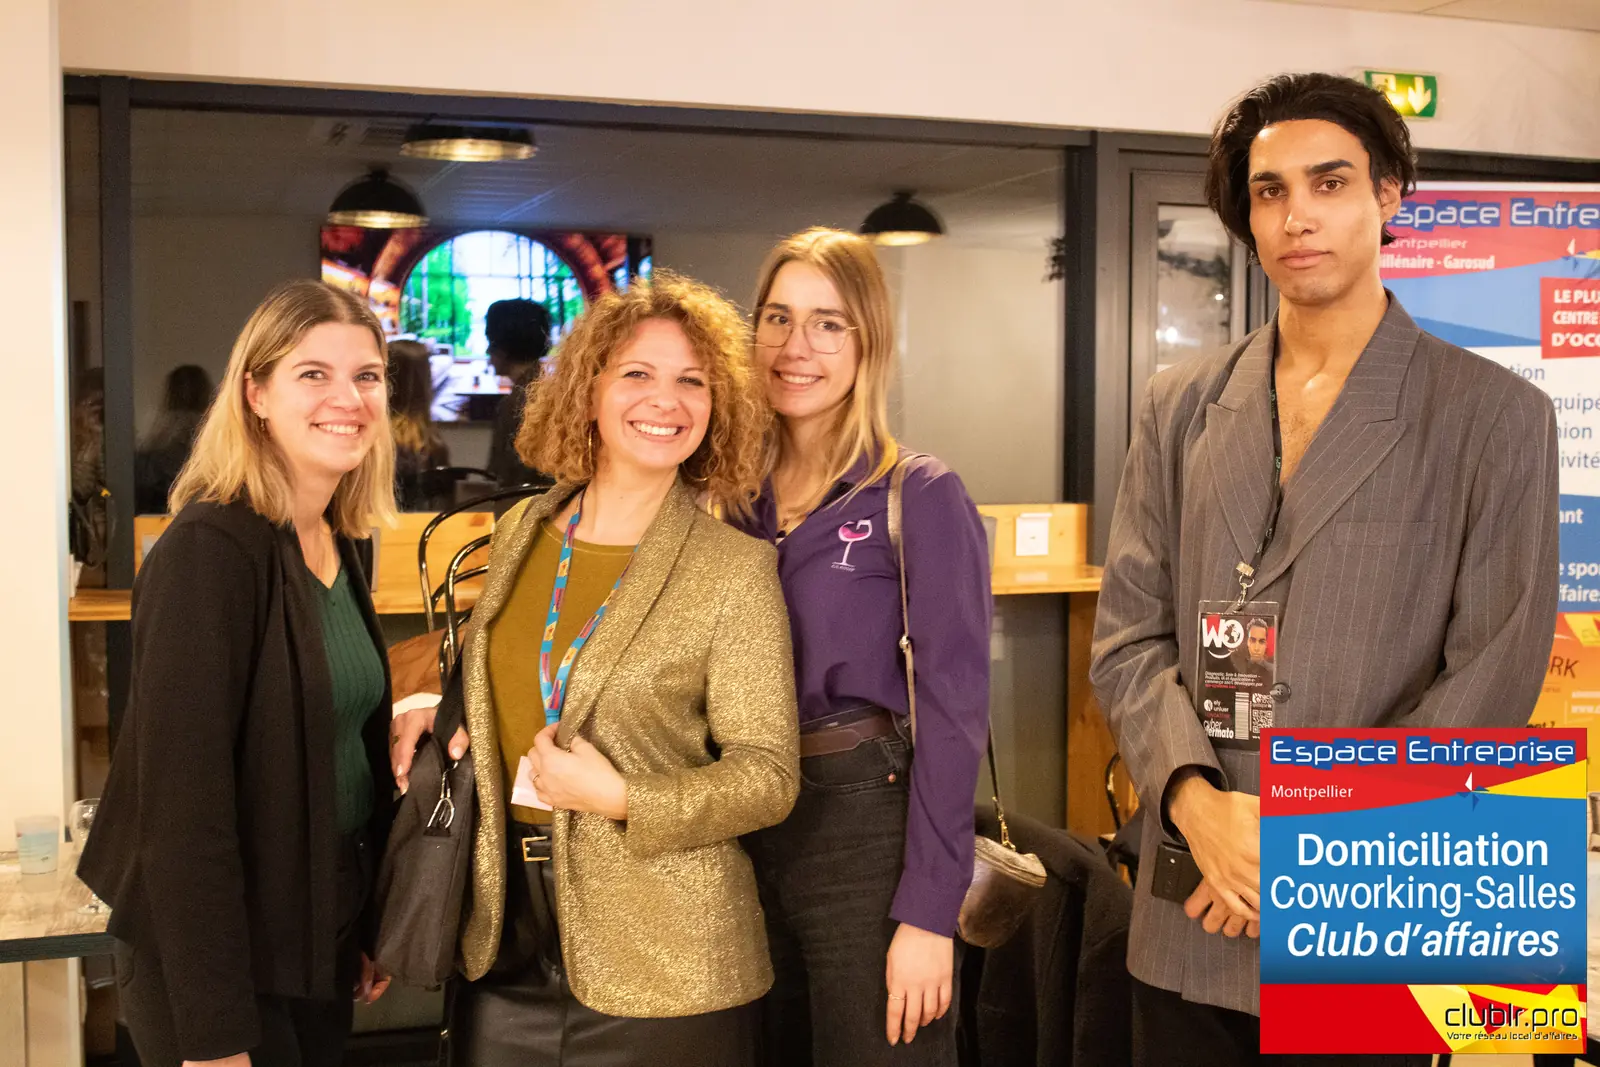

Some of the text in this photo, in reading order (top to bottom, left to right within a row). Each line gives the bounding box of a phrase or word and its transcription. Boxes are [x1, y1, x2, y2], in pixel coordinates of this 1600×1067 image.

[1387, 206, 1500, 228] space
[1387, 238, 1468, 251] ontpellier
[1443, 254, 1496, 270] Garosud
[1554, 290, 1571, 304] LE
[1552, 310, 1598, 325] CENTRE
